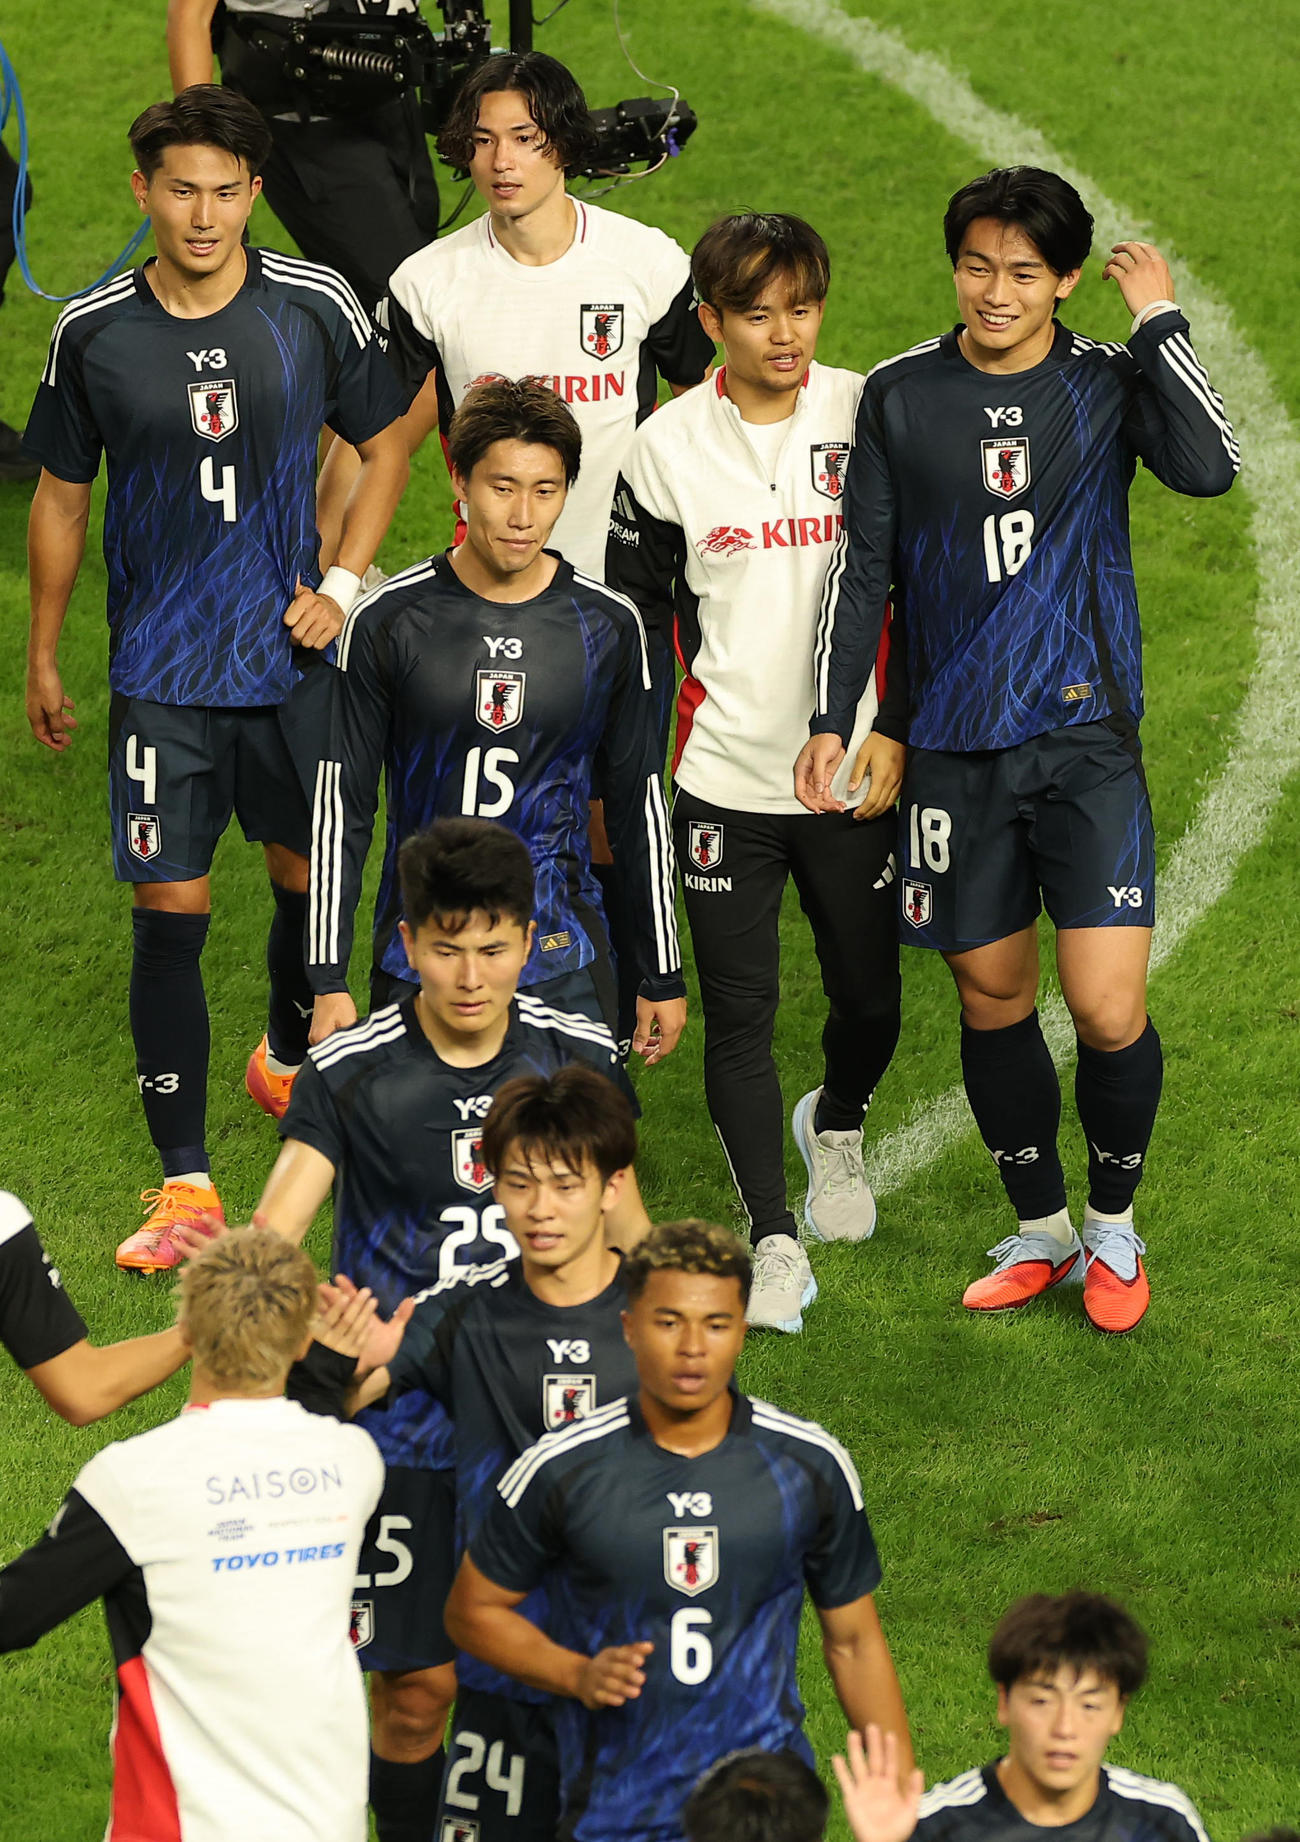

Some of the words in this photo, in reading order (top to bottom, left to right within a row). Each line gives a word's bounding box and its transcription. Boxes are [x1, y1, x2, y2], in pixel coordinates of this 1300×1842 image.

[185, 348, 228, 372] Y-3
[983, 406, 1024, 428] Y-3
[200, 456, 237, 522] 4
[983, 509, 1035, 583] 18
[482, 636, 523, 660] Y-3
[489, 672, 514, 680] JAPAN
[126, 734, 156, 805] 4
[461, 746, 520, 818] 15
[910, 803, 952, 874] 18
[684, 872, 733, 892] KIRIN
[1107, 886, 1143, 908] Y-3
[1091, 1140, 1142, 1170] Y-3
[546, 1338, 591, 1364] Y-3
[206, 1464, 343, 1505] SAISON
[666, 1492, 713, 1518] Y-3
[285, 1542, 347, 1565] TIRES
[353, 1514, 413, 1588] 5
[671, 1607, 713, 1686] 6
[445, 1731, 526, 1817] 24
